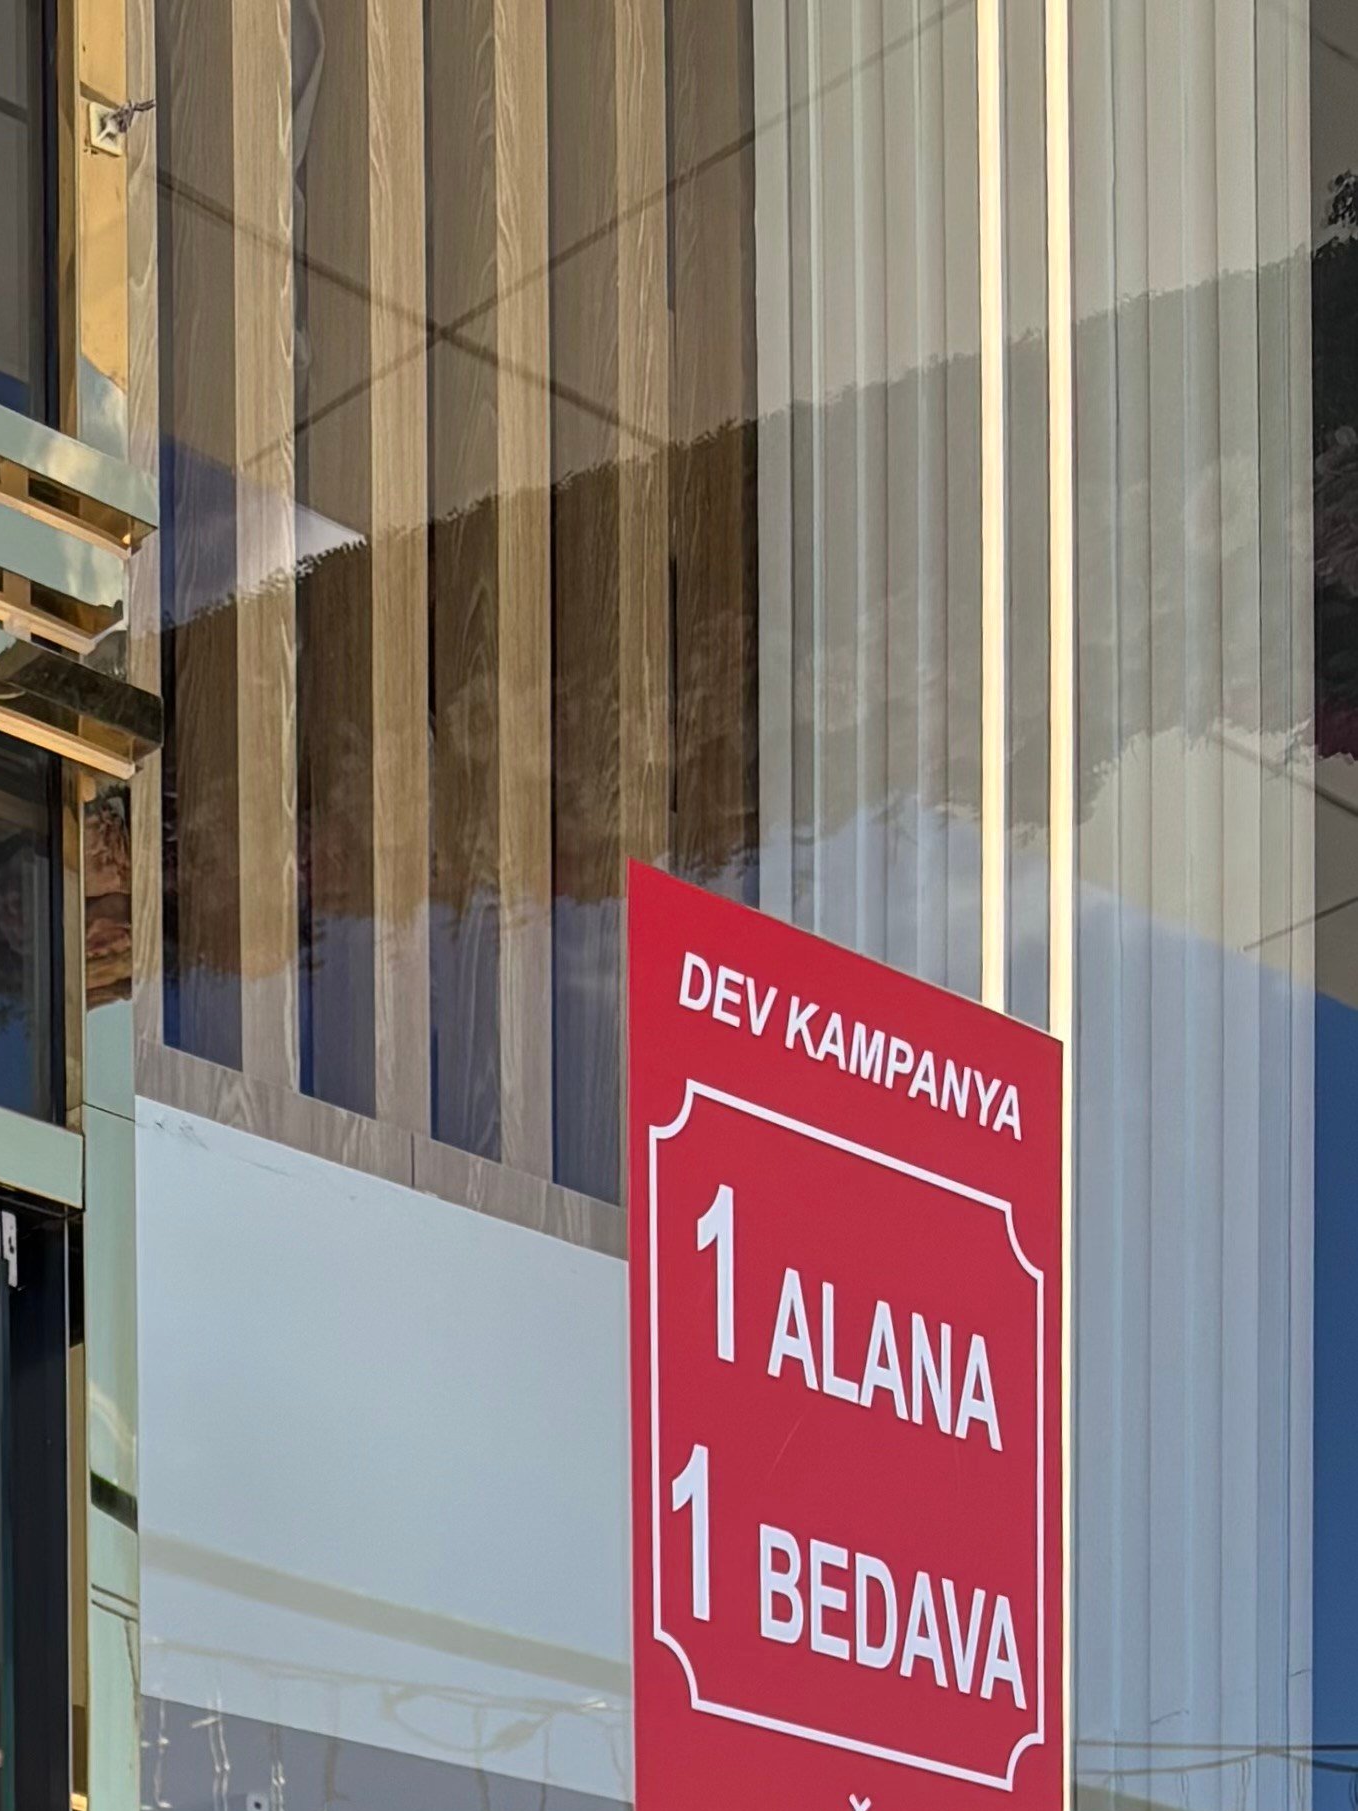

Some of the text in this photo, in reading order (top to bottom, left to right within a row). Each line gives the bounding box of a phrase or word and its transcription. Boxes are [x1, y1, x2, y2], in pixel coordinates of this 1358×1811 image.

[679, 951, 1022, 1141] DEV KAMPANYA
[696, 1184, 1002, 1451] 1 ALANA
[671, 1444, 1027, 1710] 1 BEDAVA
